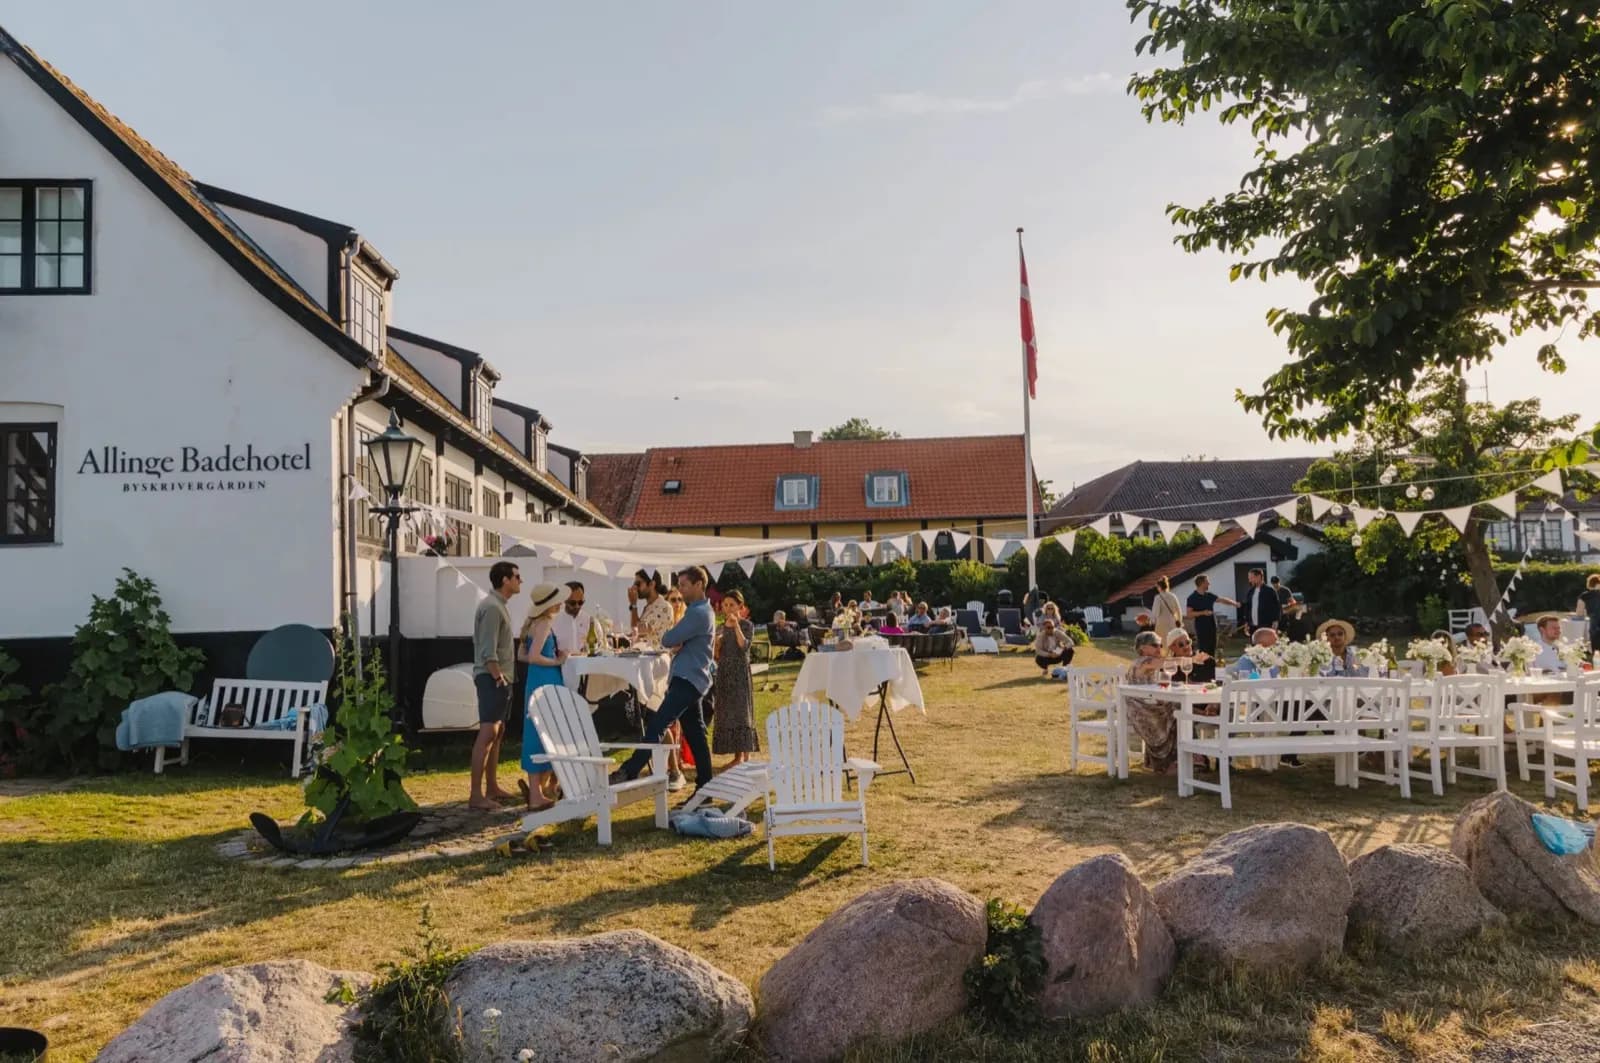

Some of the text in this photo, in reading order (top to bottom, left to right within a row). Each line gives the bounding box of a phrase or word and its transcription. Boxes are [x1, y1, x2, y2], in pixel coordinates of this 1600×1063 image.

[77, 442, 311, 478] Allinge Badehotel
[122, 479, 266, 492] BYSKRIVERGÅRDEN
